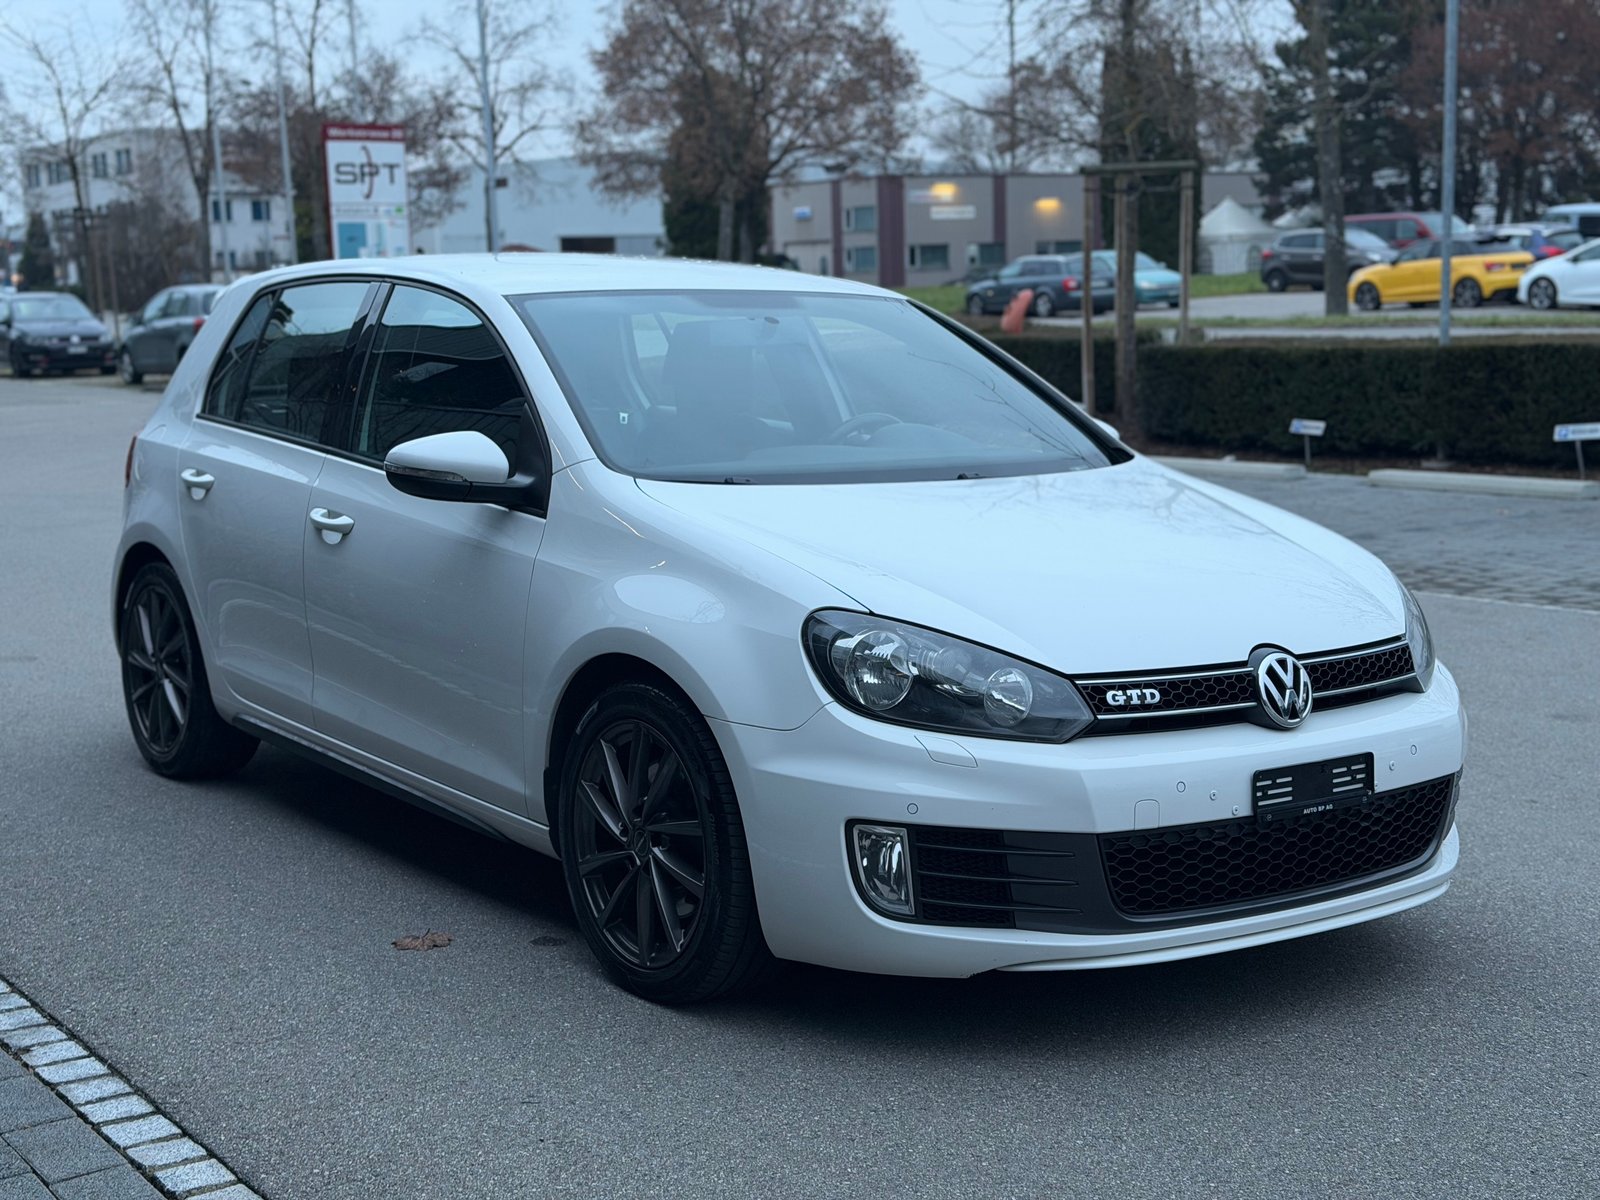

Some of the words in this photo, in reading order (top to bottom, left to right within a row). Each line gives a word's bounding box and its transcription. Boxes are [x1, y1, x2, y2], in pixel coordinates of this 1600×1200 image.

[335, 162, 401, 184] SPT
[1106, 688, 1162, 706] GTD
[1303, 807, 1318, 815] AUTO
